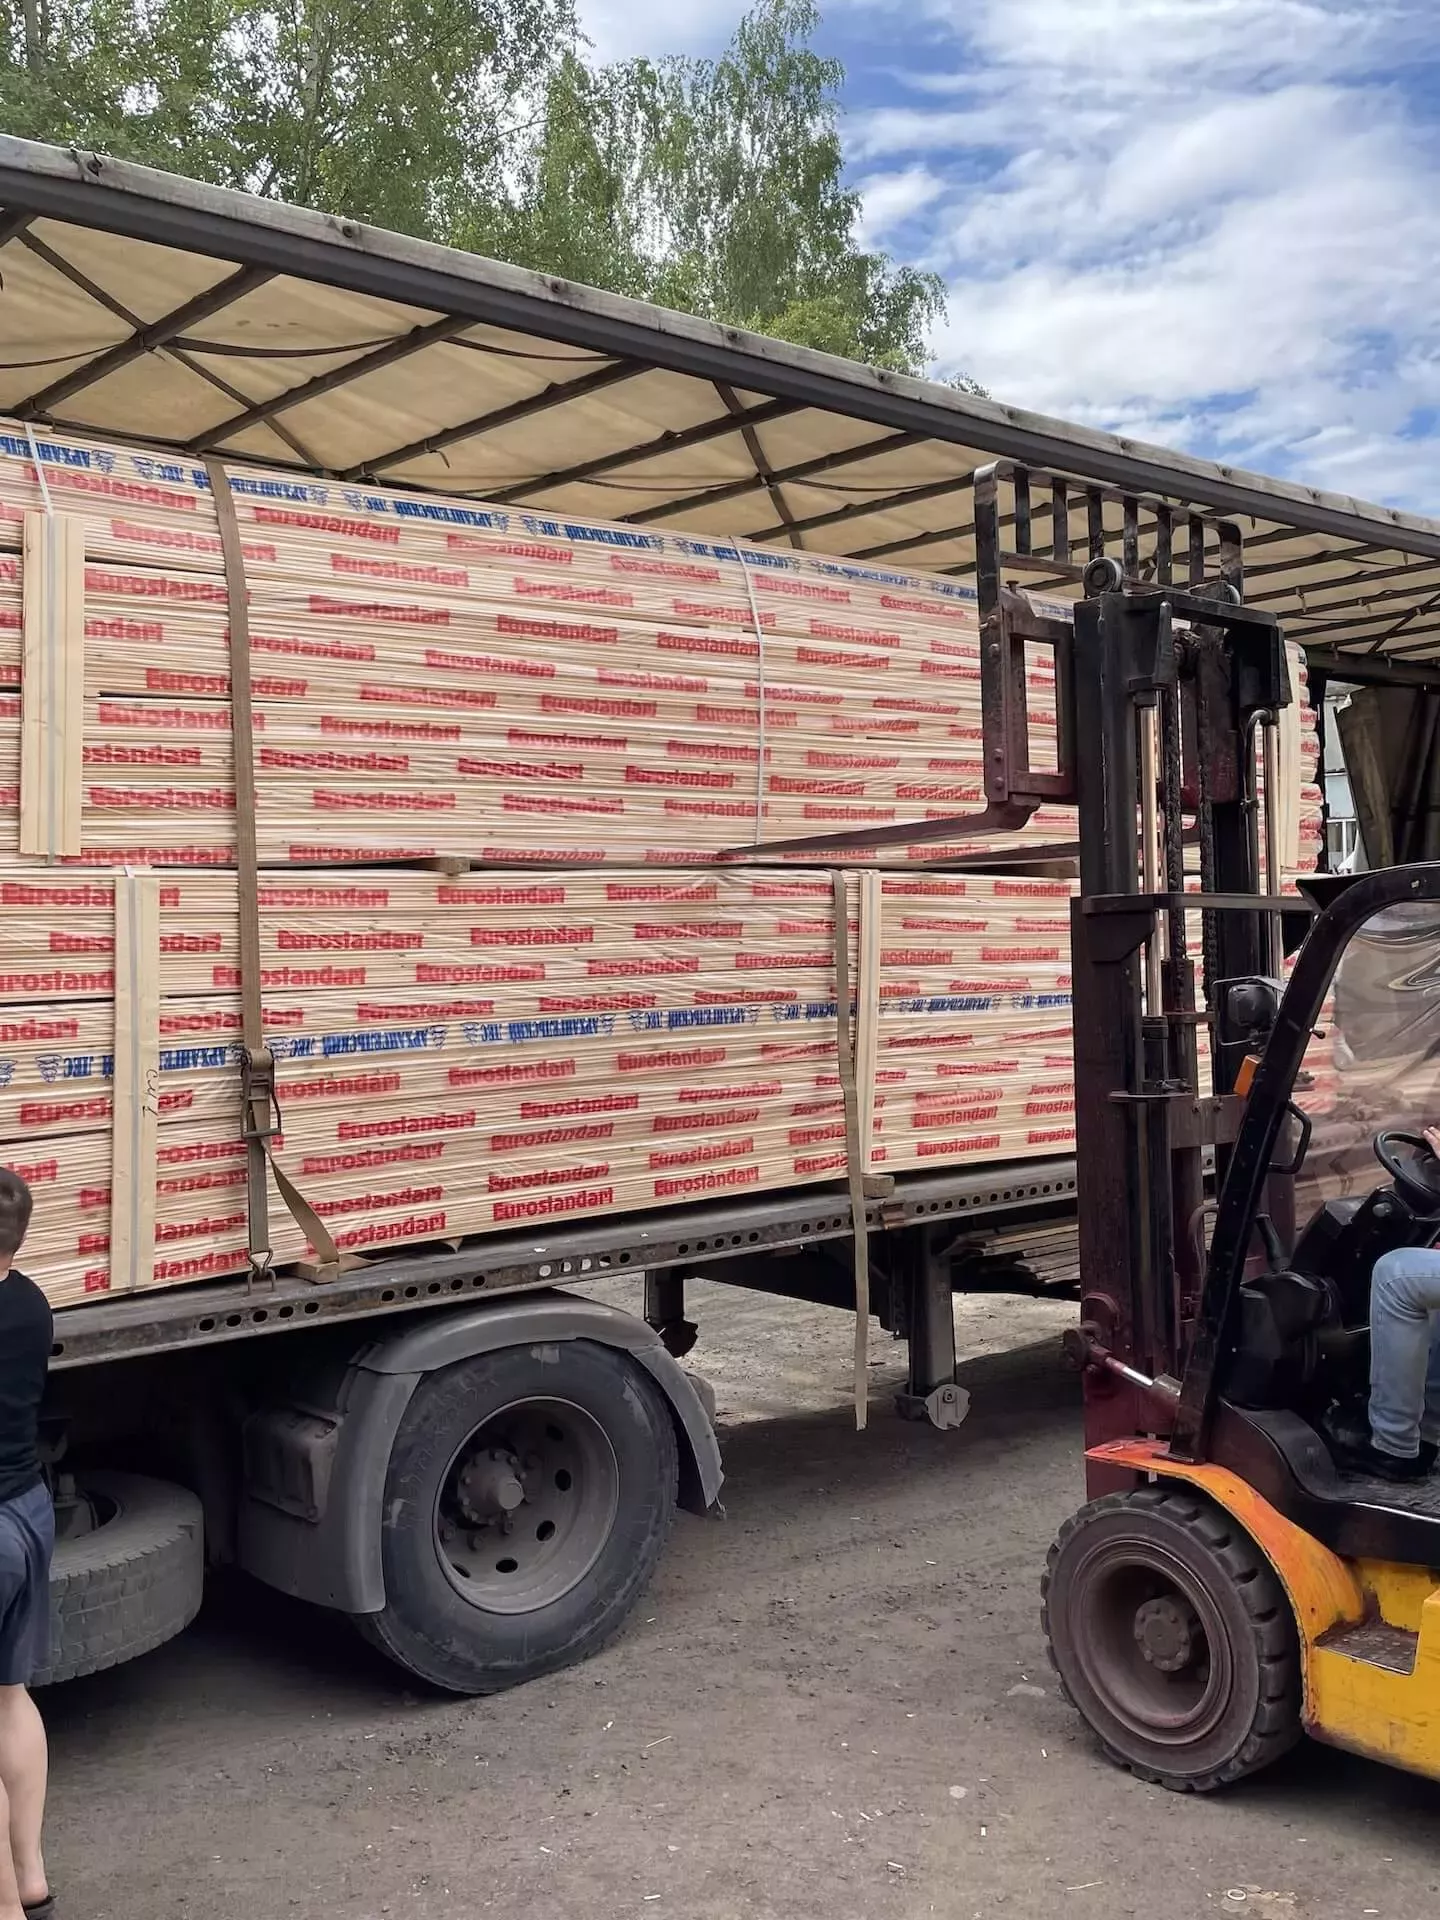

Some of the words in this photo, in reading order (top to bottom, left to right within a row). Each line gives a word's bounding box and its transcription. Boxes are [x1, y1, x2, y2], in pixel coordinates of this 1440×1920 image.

[624, 764, 736, 788] Eurostandart
[212, 966, 366, 987] Euostandart
[415, 963, 545, 984] Eurostandart
[481, 1024, 504, 1042] ЛЕС
[508, 1017, 599, 1043] АРХАНГЕЛЬСКИЙ
[290, 1037, 315, 1057] ЛЕС
[322, 1030, 428, 1059] АРХАНГЕЛЬСКИЙ
[63, 1055, 94, 1078] ЛЕС
[614, 1048, 726, 1073] Eurostandart
[447, 1059, 575, 1088] Eurostandart
[519, 1095, 639, 1119] Eurostandart
[913, 1105, 999, 1128] Eurostandart
[337, 1111, 476, 1141] Eurostandart
[650, 1109, 761, 1134] Eurostandart
[488, 1123, 615, 1153] Eurostandart
[915, 1136, 1000, 1156] Eurostandart
[299, 1142, 444, 1175] Eurostandart
[648, 1138, 753, 1169] Eurostandart
[488, 1164, 608, 1193] Eurostandart
[654, 1168, 759, 1197] Eurostandart
[492, 1188, 613, 1221] Eurostandart
[303, 1211, 448, 1260] rostandart
